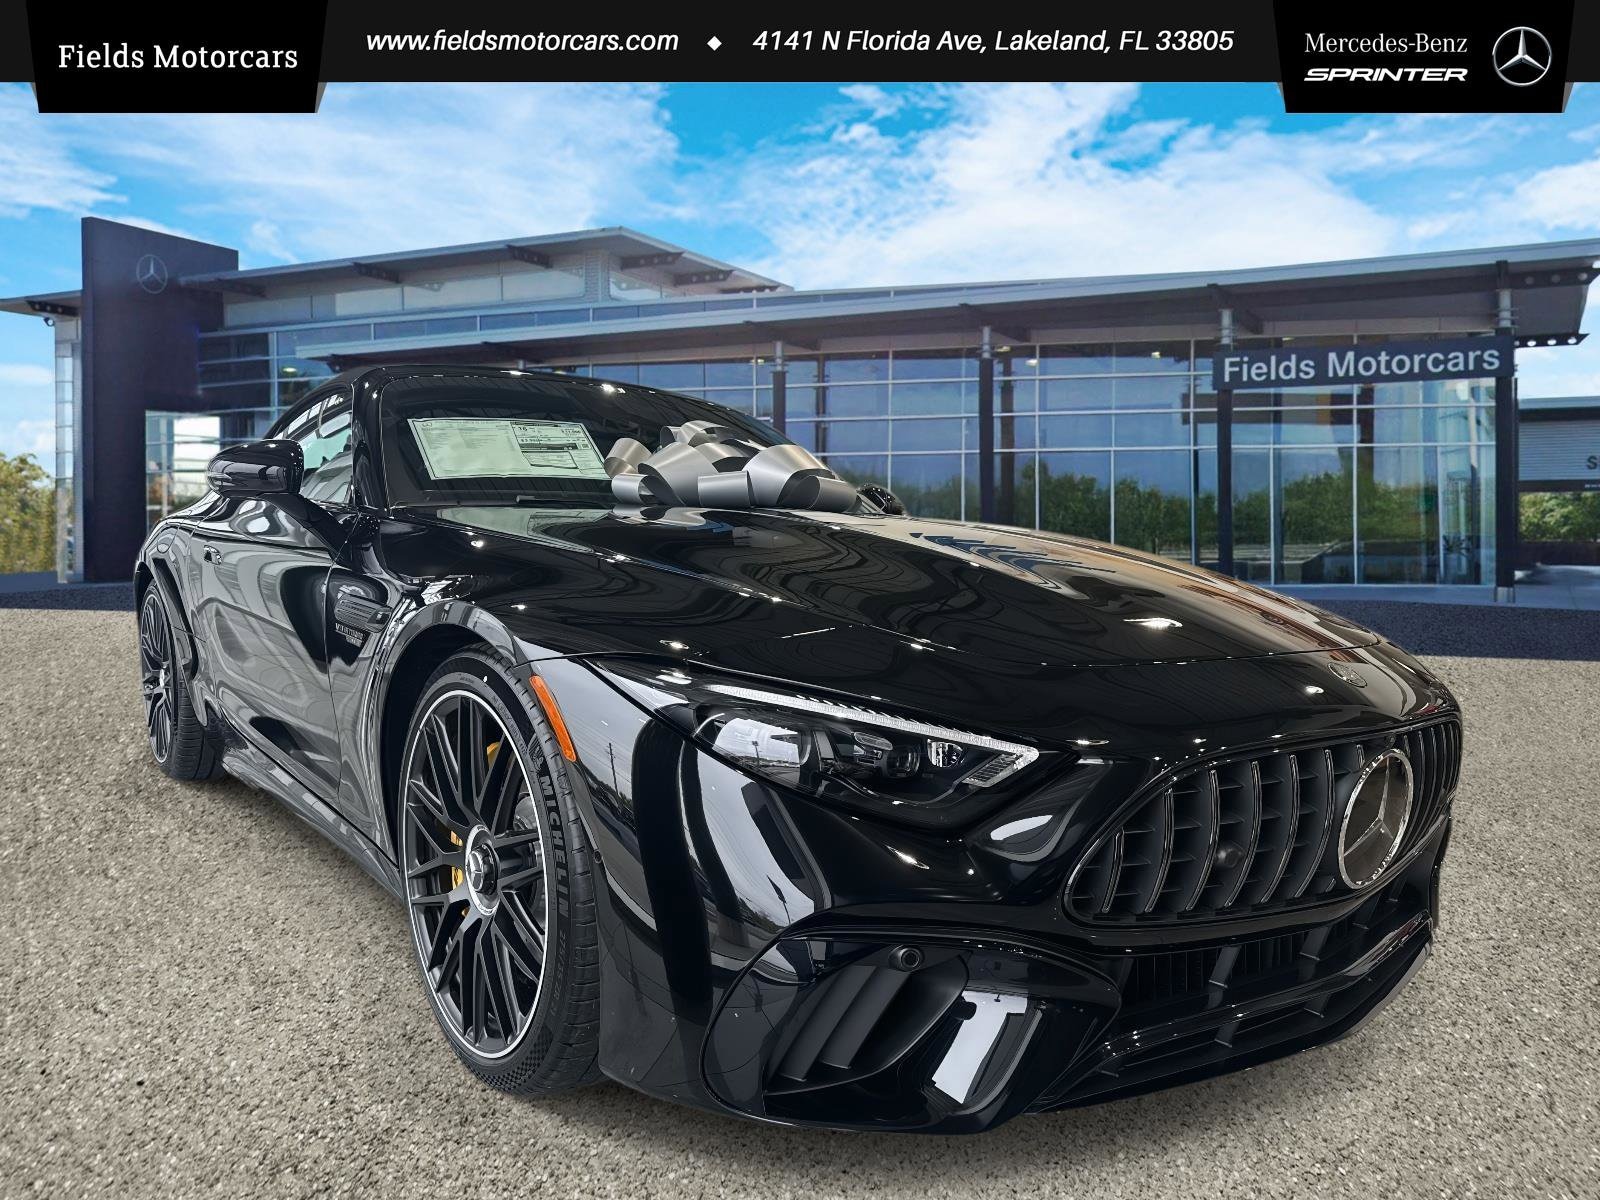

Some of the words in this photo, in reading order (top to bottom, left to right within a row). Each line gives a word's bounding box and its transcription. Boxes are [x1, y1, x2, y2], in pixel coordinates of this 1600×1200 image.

[1223, 353, 1316, 383] Fields
[1327, 348, 1501, 378] Motorcars
[539, 775, 571, 919] MICHELIN
